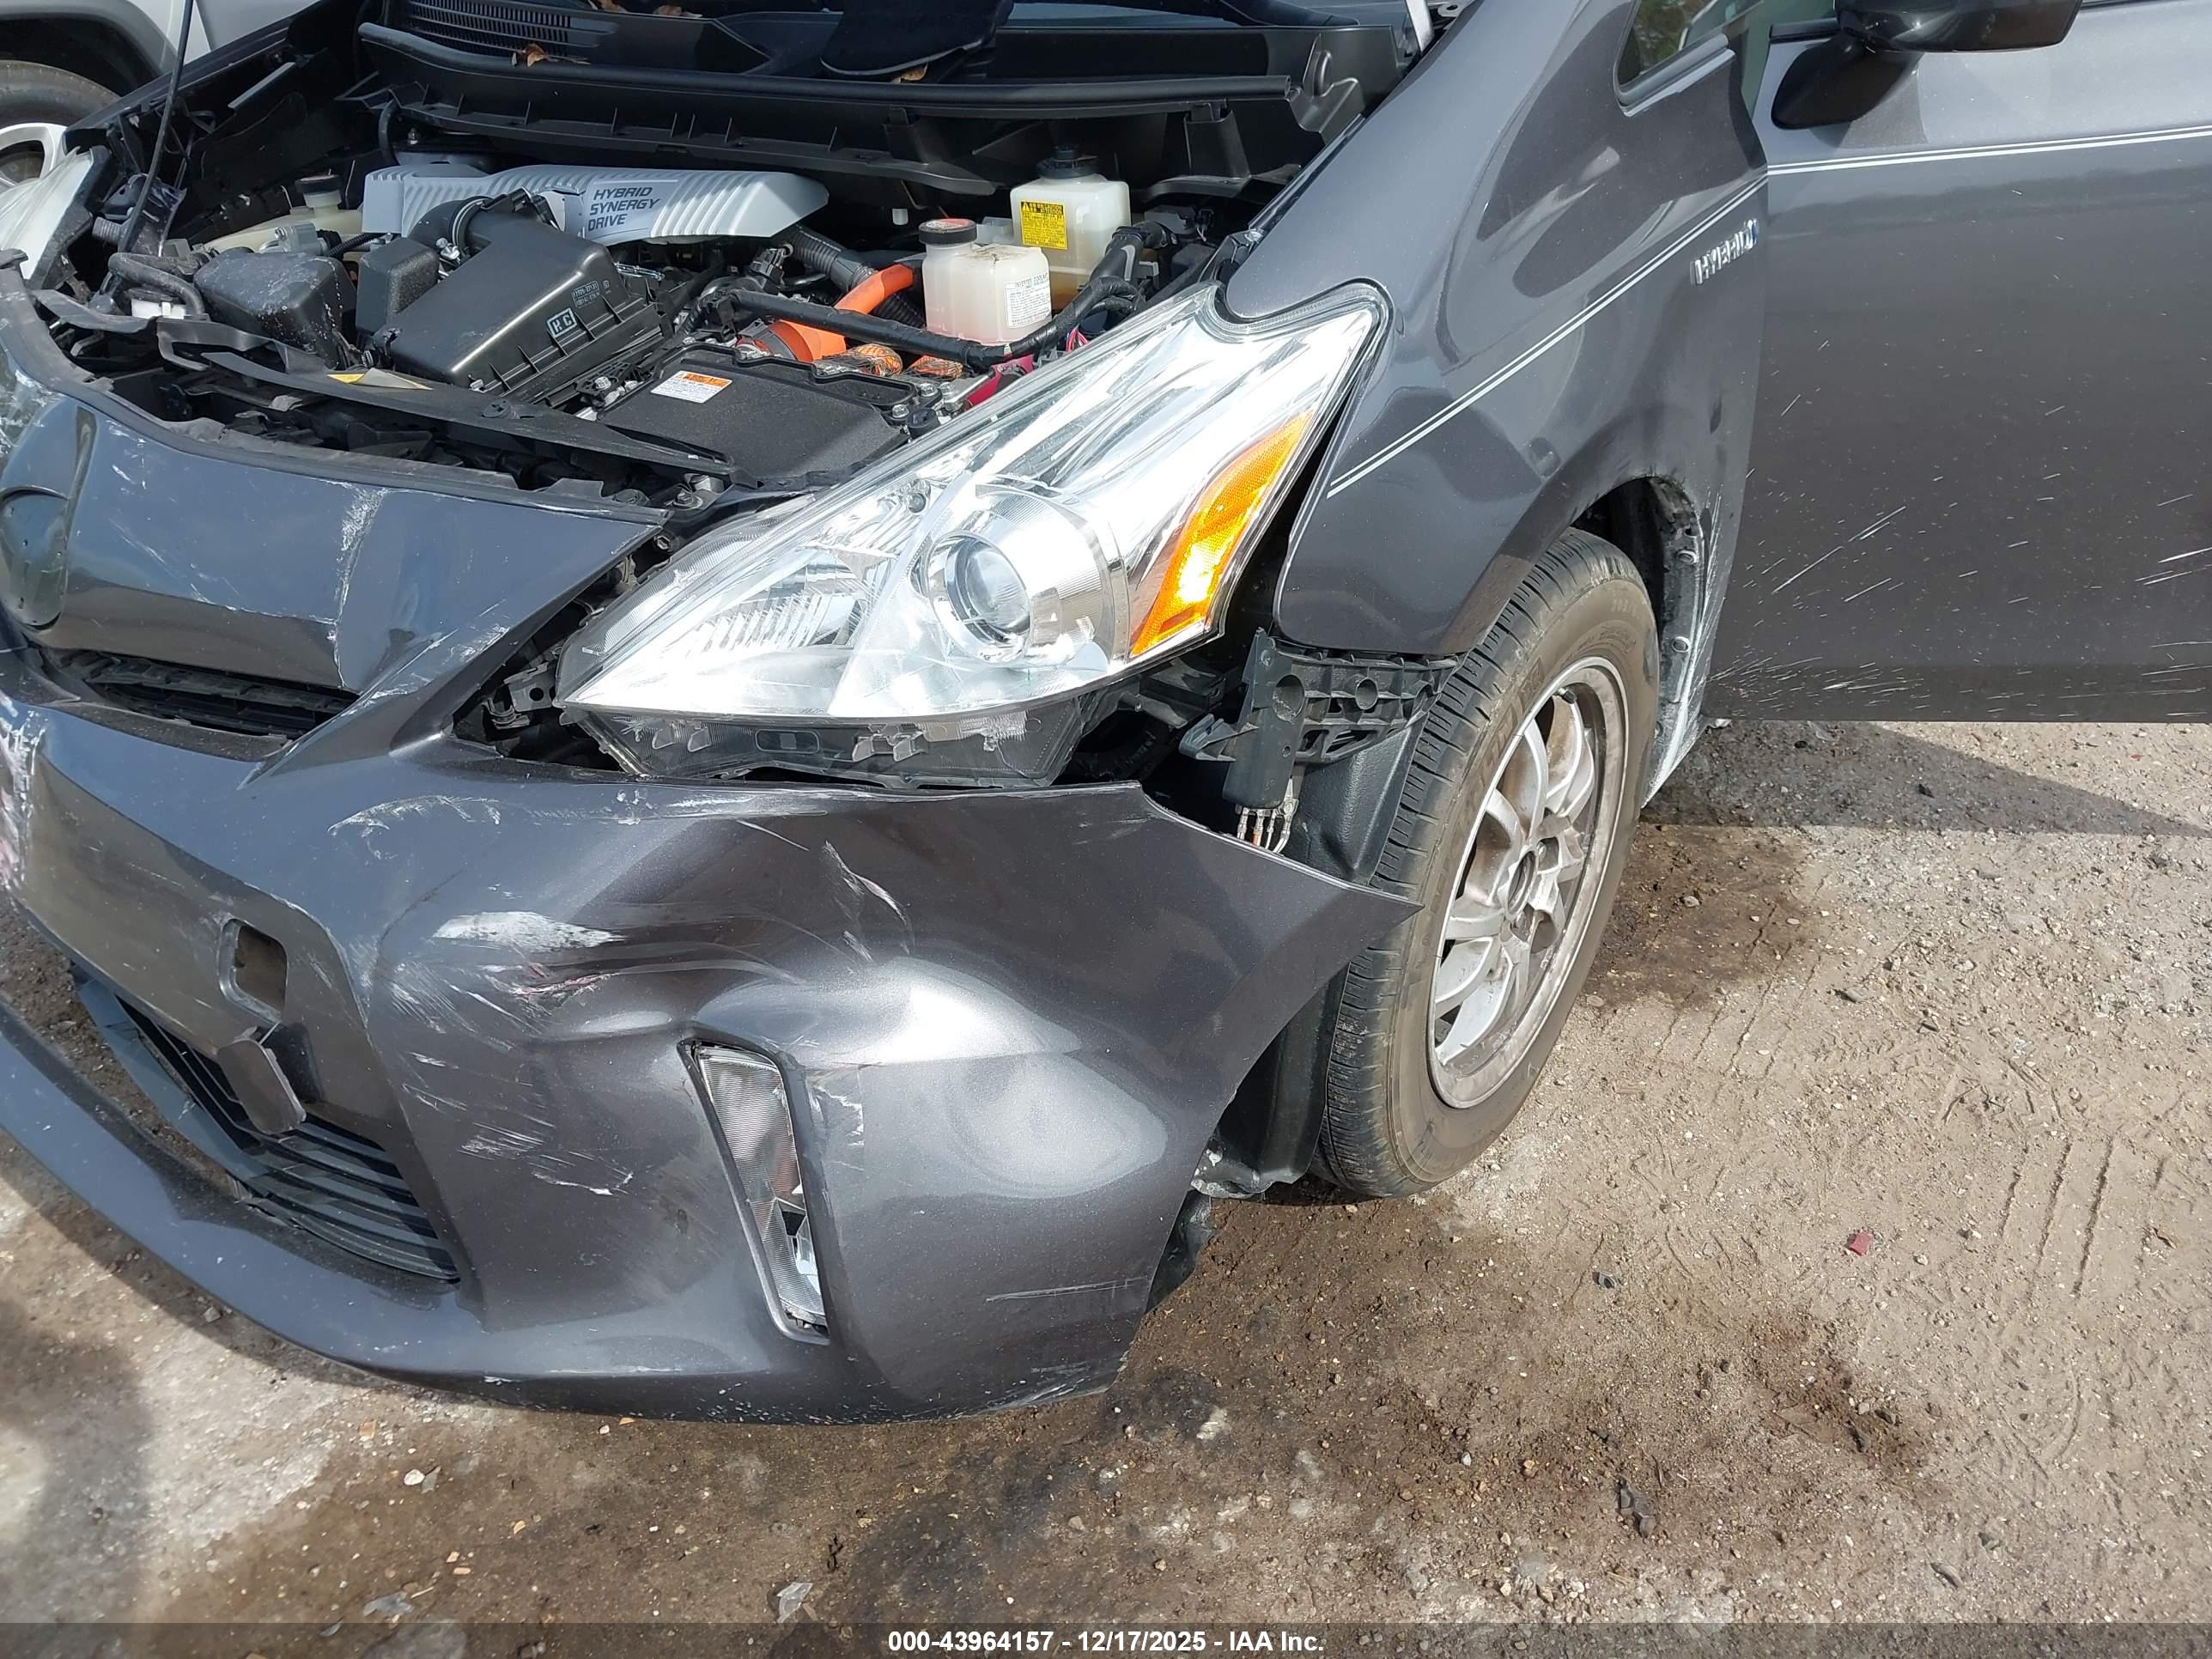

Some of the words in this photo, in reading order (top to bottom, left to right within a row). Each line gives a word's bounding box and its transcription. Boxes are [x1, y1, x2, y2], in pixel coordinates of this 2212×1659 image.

[593, 187, 653, 200] HYBRID
[589, 198, 659, 216] SYNERGY
[588, 214, 627, 231] DRIVE
